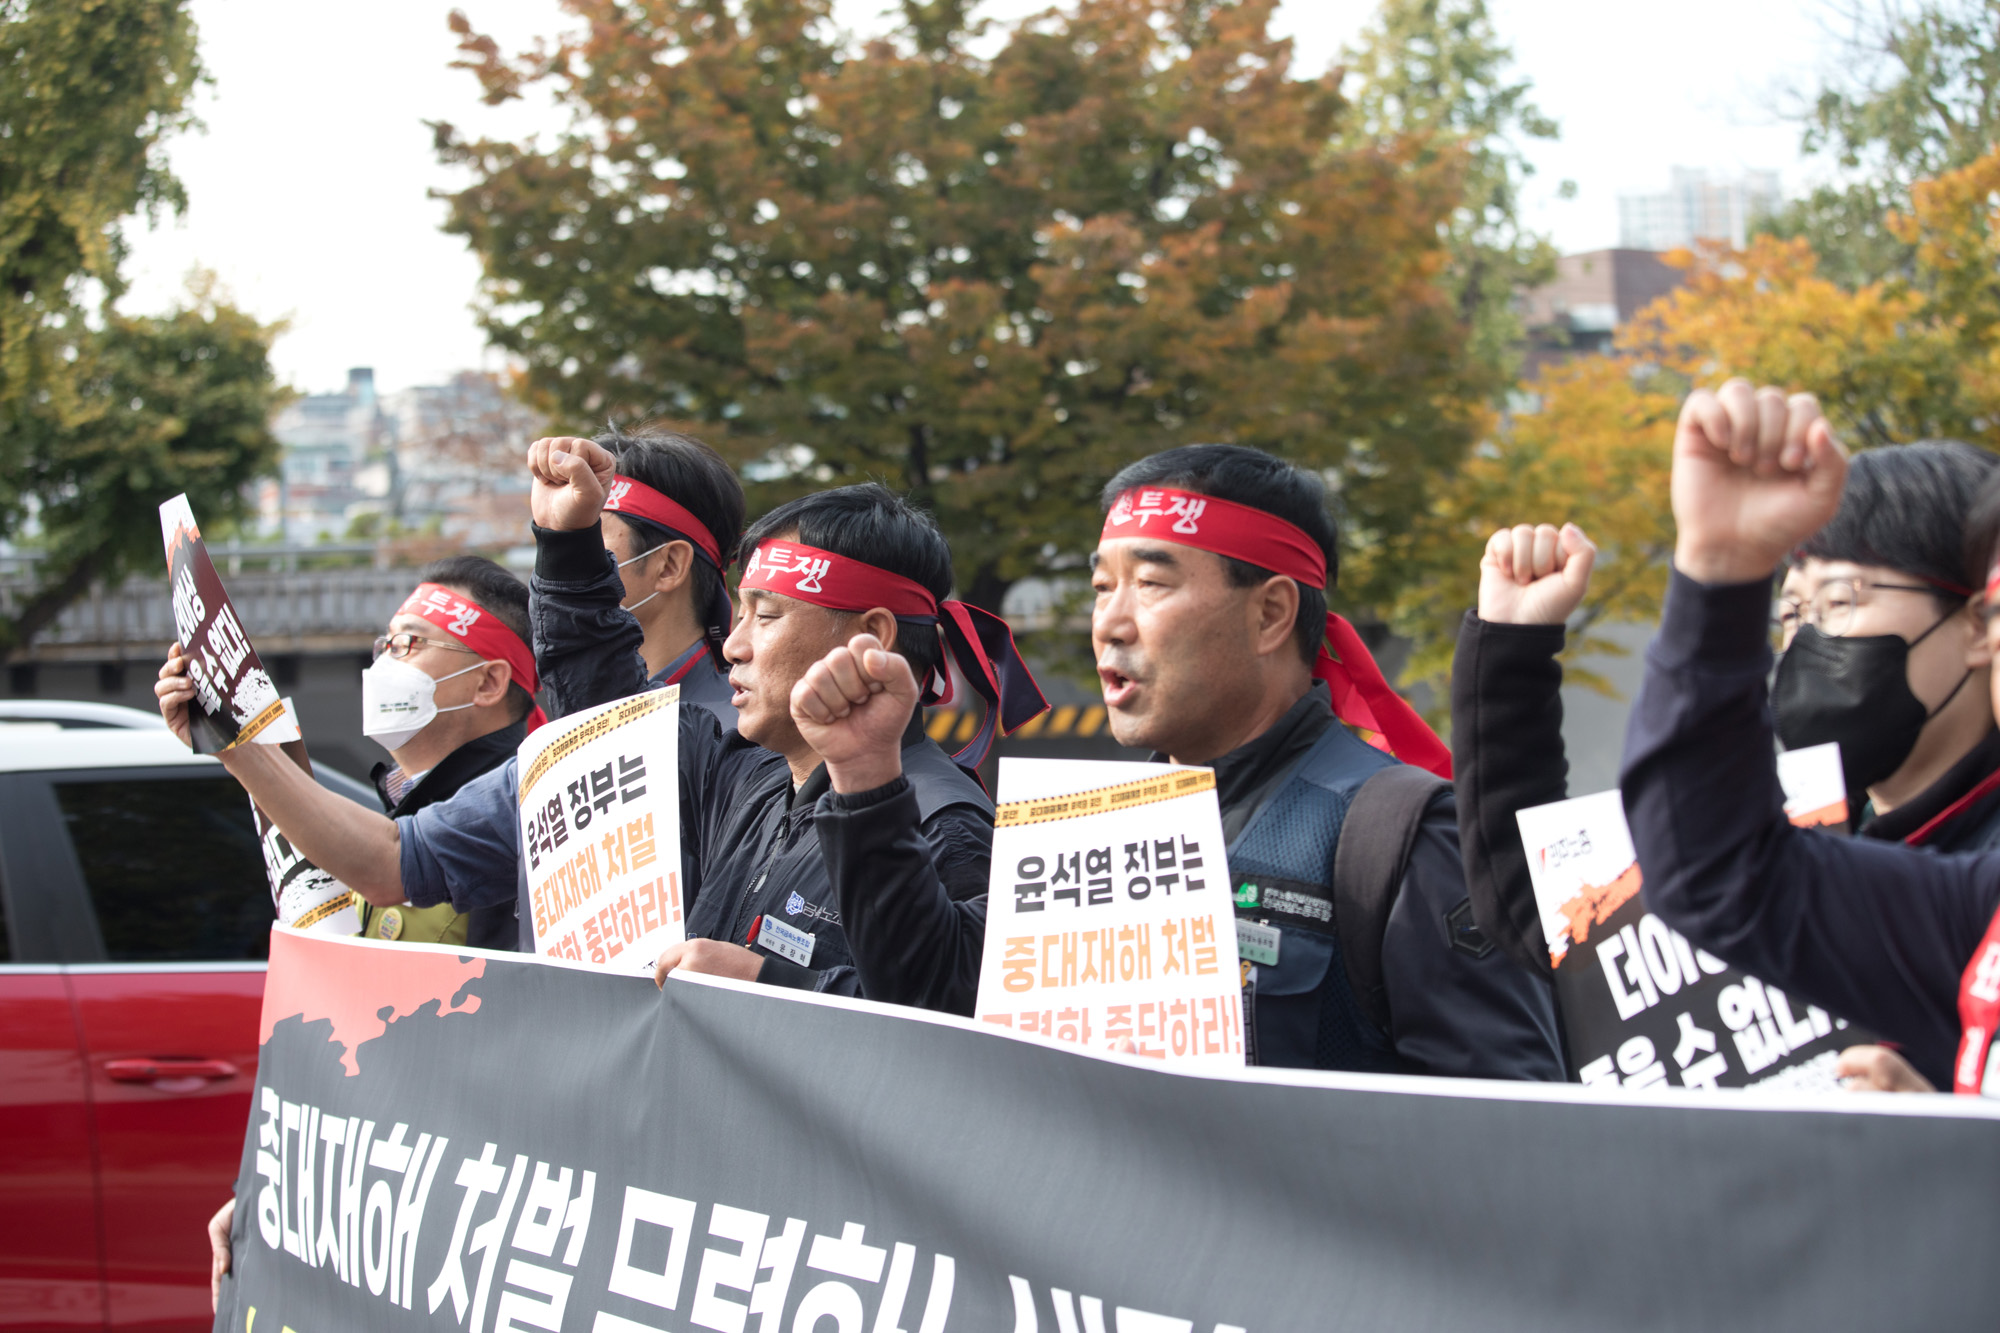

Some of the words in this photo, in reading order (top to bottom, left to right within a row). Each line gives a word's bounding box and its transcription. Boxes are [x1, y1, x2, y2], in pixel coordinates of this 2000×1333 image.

[1132, 491, 1207, 535] 투쟁
[761, 546, 831, 593] 투쟁
[420, 589, 481, 637] 투쟁
[187, 658, 222, 717] 을
[528, 793, 569, 872] 윤석열
[567, 753, 648, 832] 정부는
[534, 848, 602, 939] 중대재해
[602, 811, 657, 883] 처벌
[1014, 846, 1113, 914] 윤석열
[1124, 833, 1206, 900] 정부는
[582, 870, 682, 965] 중단하라!
[1002, 925, 1152, 993] 중대재해
[1162, 914, 1219, 976] 처벌
[1596, 913, 1728, 1021] 더이
[1105, 995, 1241, 1060] 중단하라!
[257, 1086, 449, 1310] 중대재해
[427, 1142, 596, 1333] 처벌
